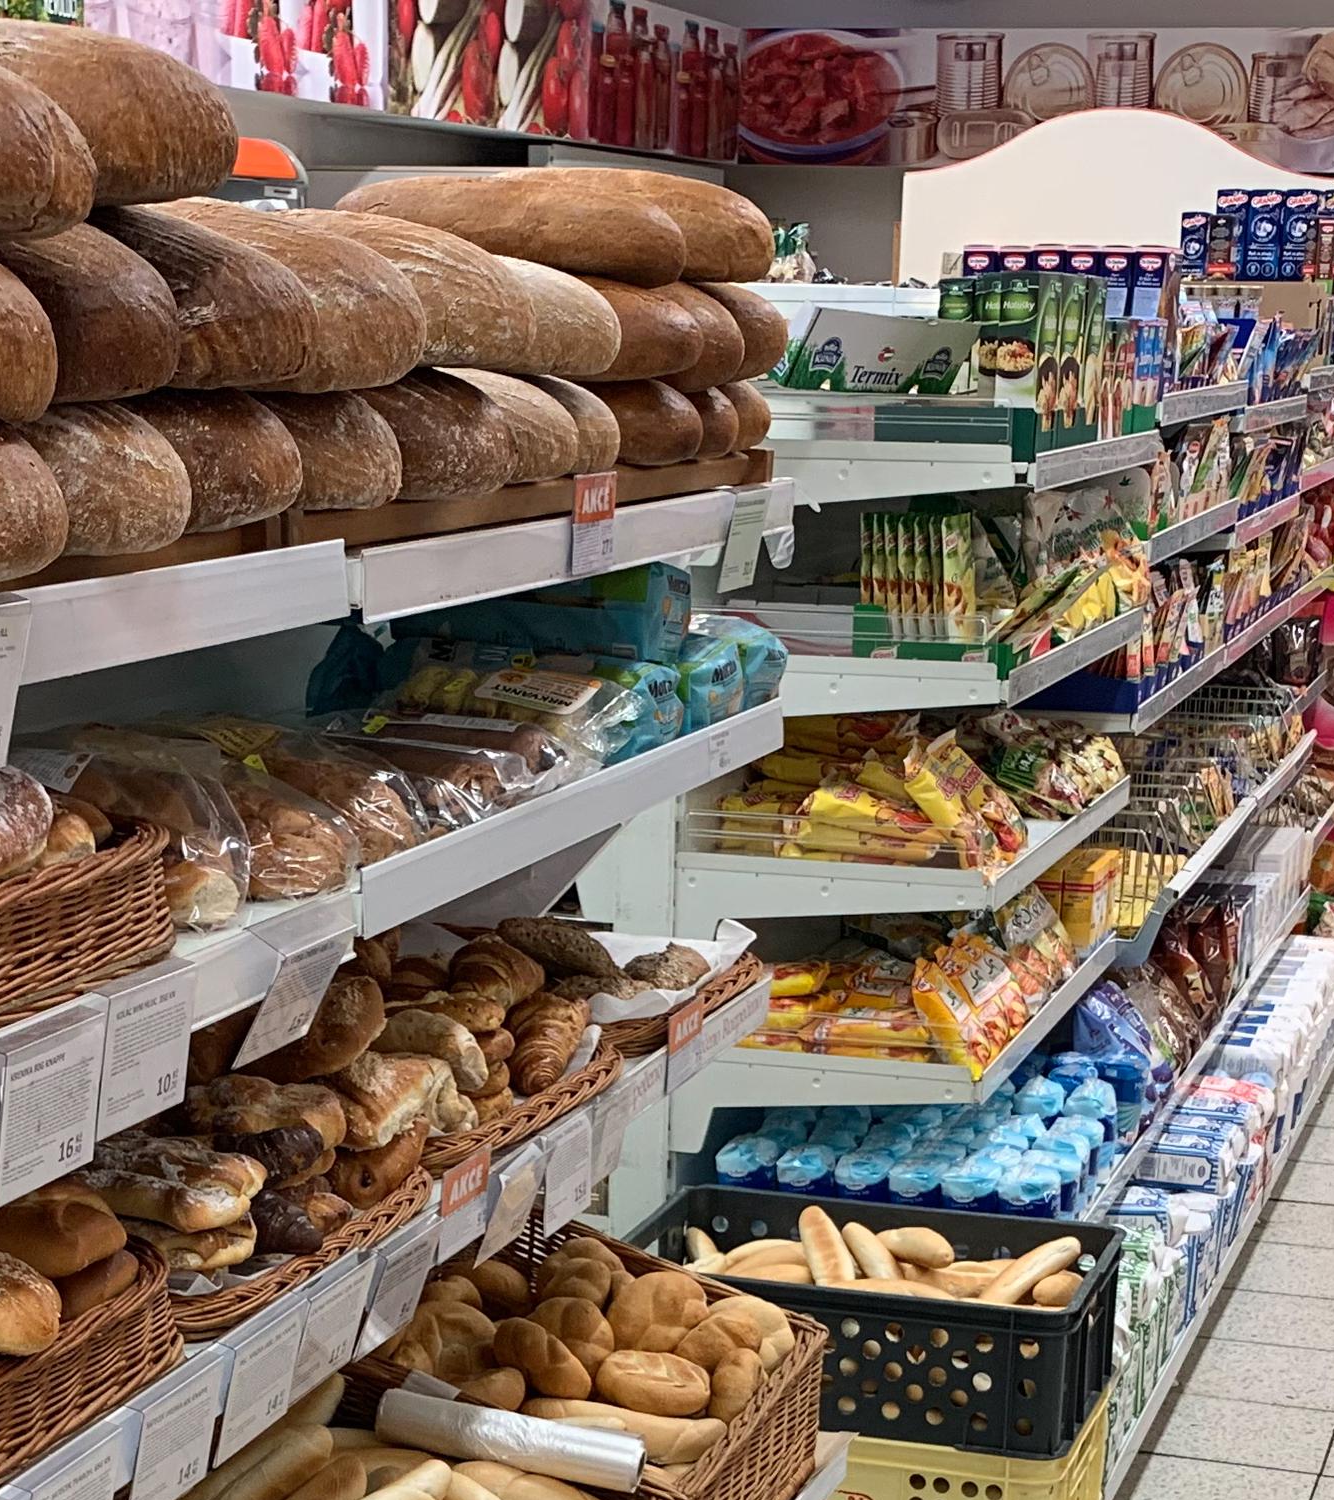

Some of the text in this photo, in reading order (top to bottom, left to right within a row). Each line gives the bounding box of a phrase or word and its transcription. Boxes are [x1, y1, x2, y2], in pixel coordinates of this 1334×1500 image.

[850, 364, 905, 388] Termix
[581, 486, 612, 515] AKCE
[448, 1164, 484, 1206] AKCE
